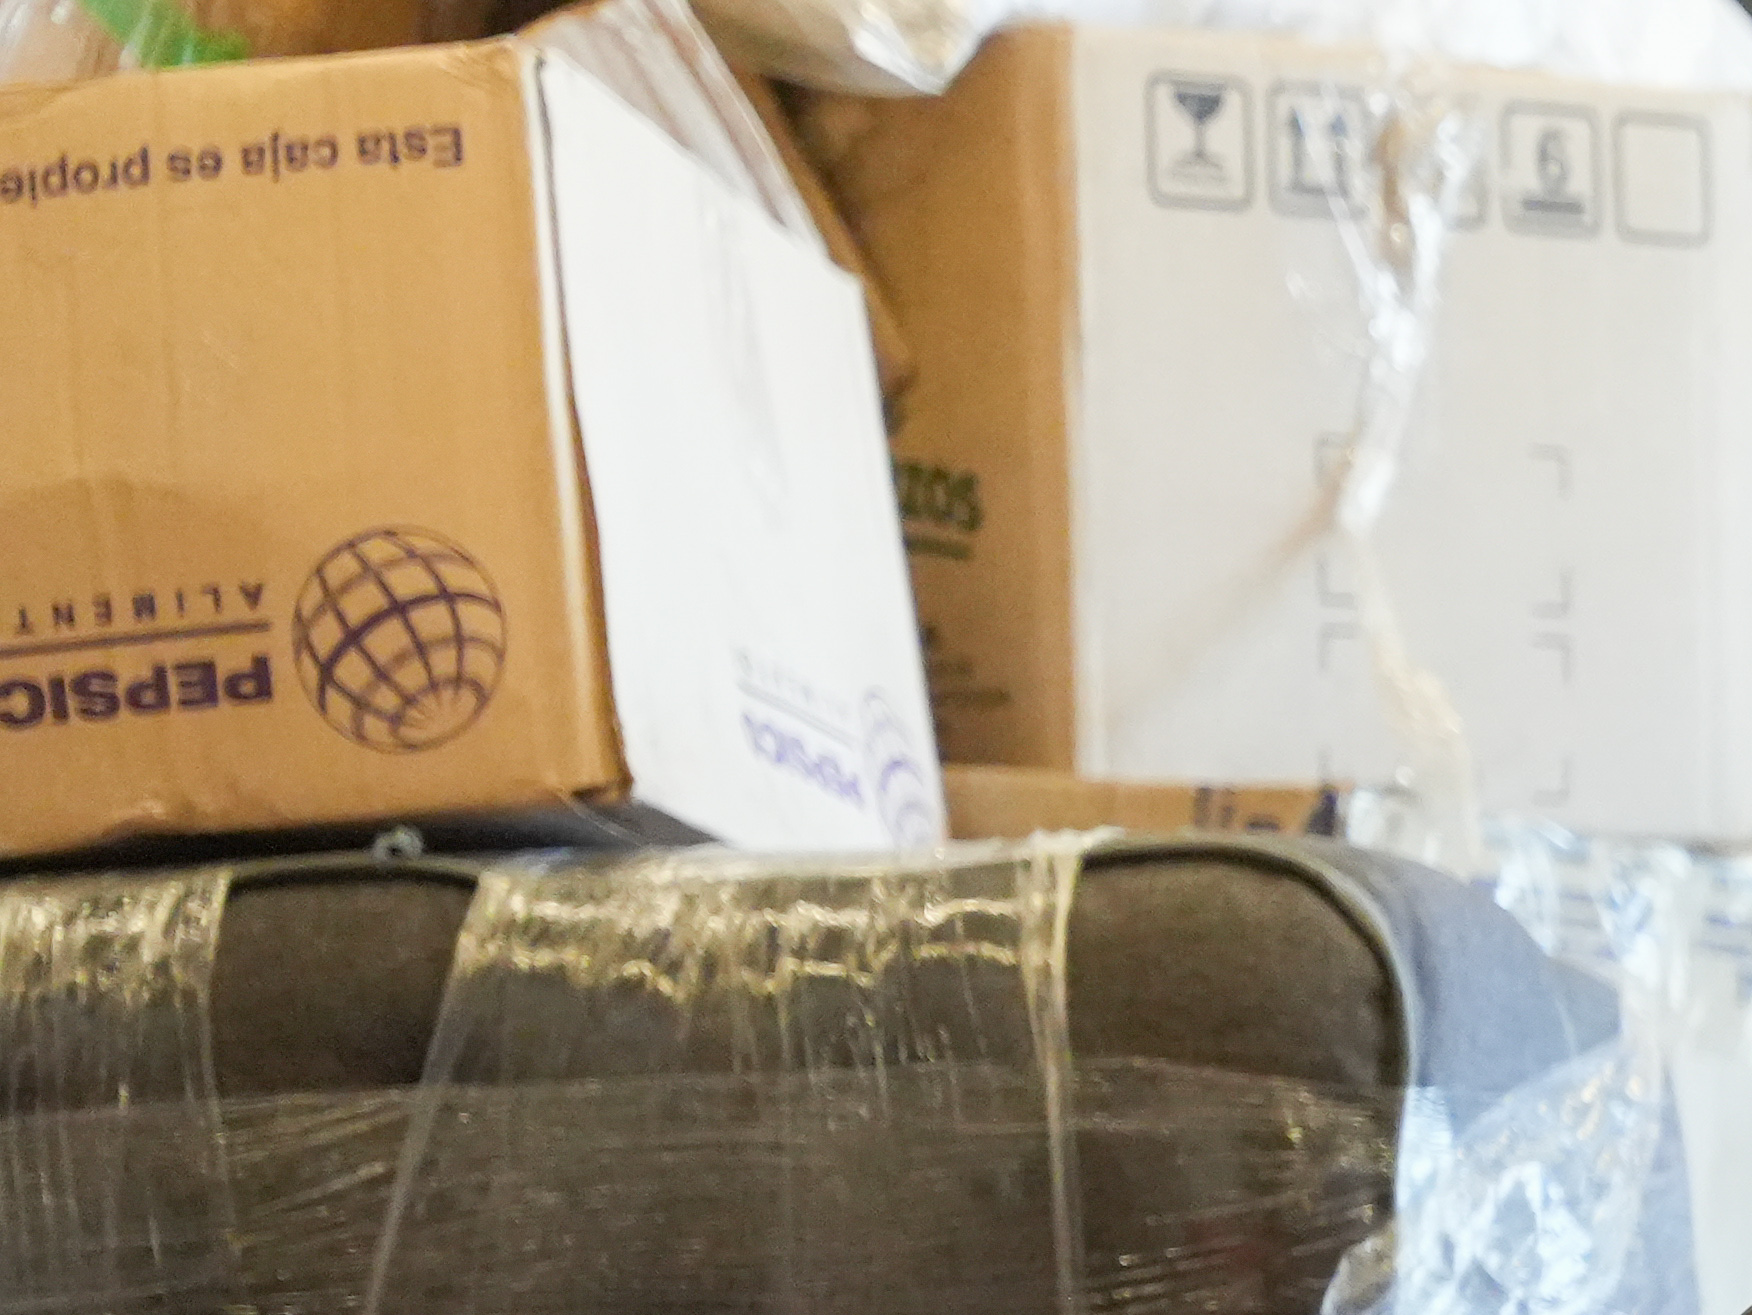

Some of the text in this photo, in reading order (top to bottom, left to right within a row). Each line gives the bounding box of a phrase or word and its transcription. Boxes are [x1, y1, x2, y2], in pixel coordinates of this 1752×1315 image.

[166, 146, 224, 183] es
[240, 128, 339, 185] caja
[355, 125, 465, 171] Esta
[0, 654, 273, 733] PEPSIC
